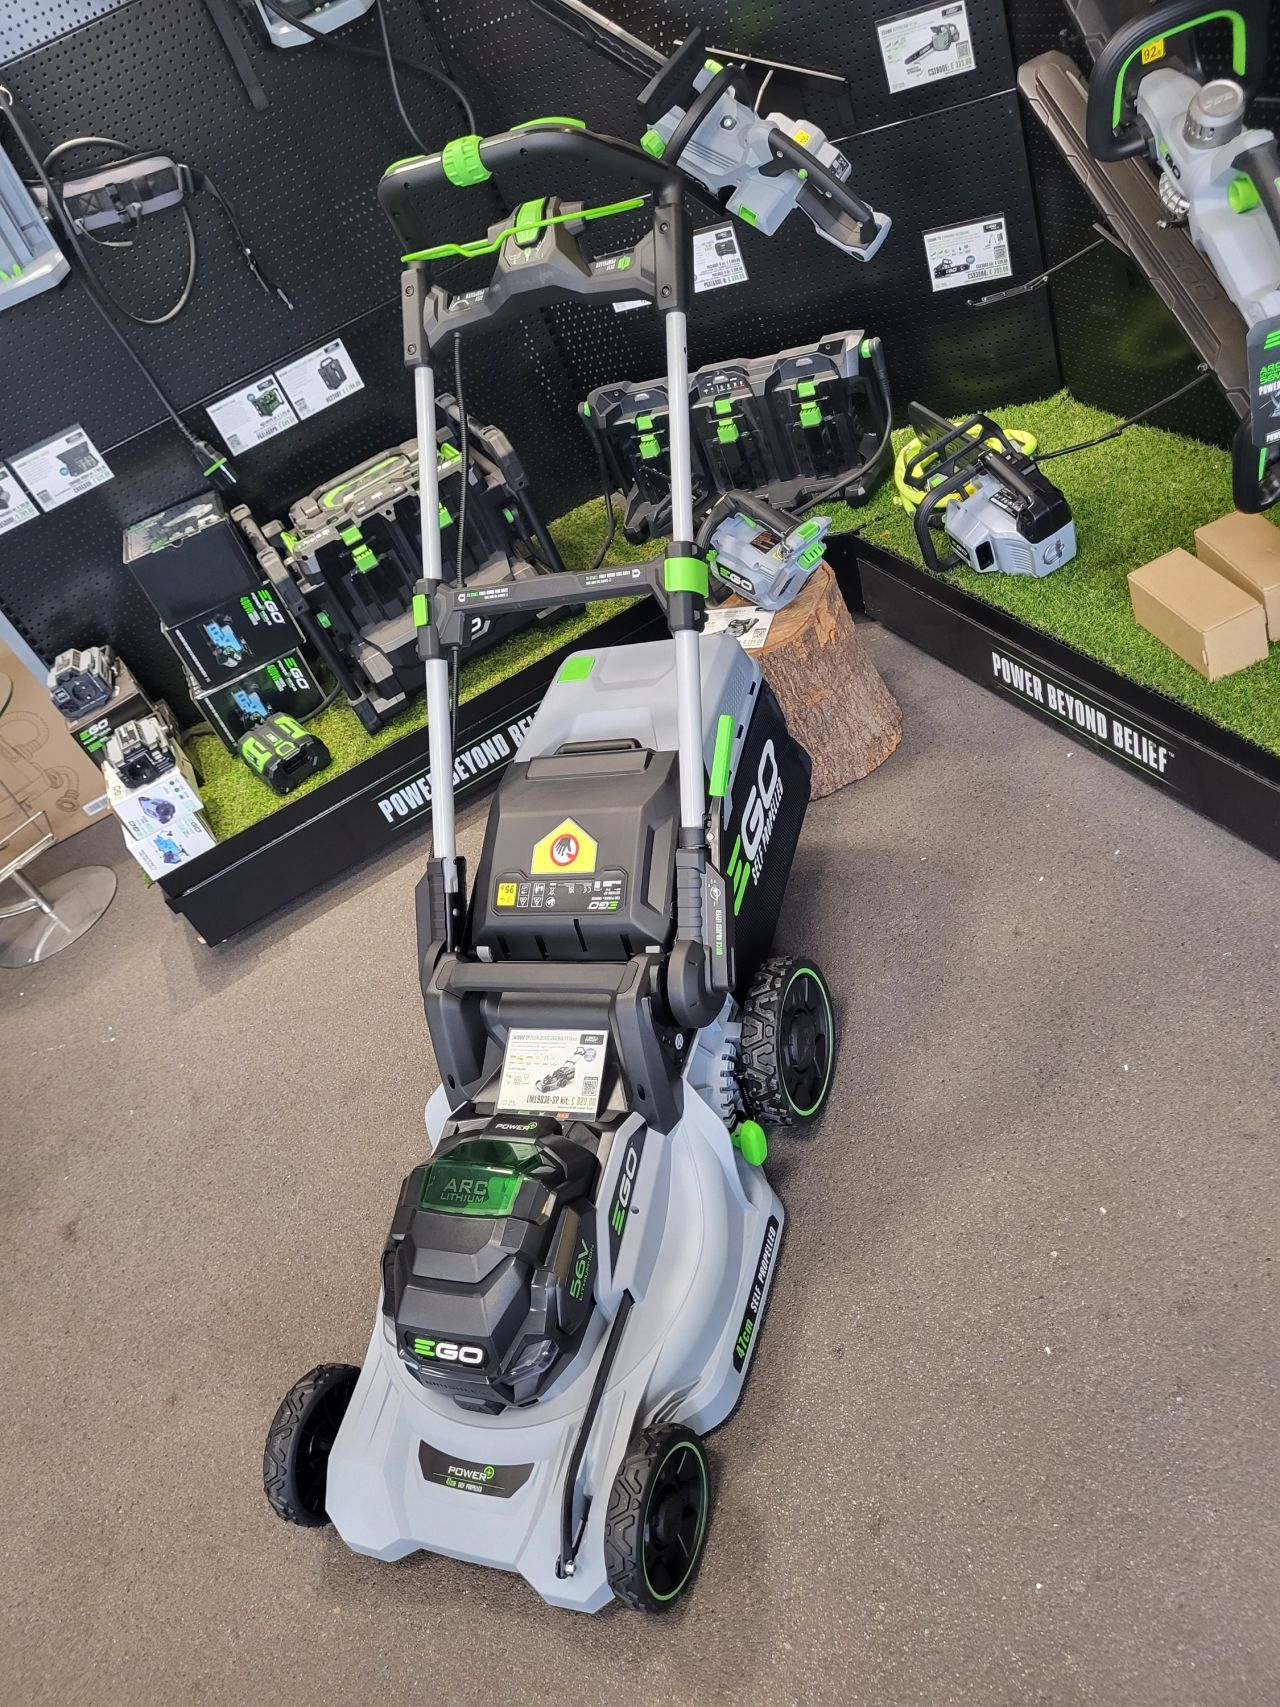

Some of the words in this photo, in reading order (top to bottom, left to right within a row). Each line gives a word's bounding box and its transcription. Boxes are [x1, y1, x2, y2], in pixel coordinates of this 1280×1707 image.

[1143, 46, 1157, 59] 92
[719, 567, 752, 591] EGO
[257, 590, 285, 623] EGO
[284, 657, 310, 689] EGO
[991, 651, 1044, 704] POWER
[1047, 683, 1108, 740] BEYOND
[79, 718, 108, 741] EGO
[378, 773, 432, 824] POWE
[726, 739, 778, 916] EGO
[751, 844, 764, 886] SELF
[762, 776, 784, 853] PROPELLED
[587, 901, 618, 910] EGO
[440, 1192, 485, 1204] LITHIUM
[443, 1178, 488, 1195] ARC
[612, 1147, 637, 1236] EGO
[570, 1238, 589, 1299] 56V
[735, 1317, 754, 1359] 47cm
[750, 1285, 763, 1313] SELF
[758, 1225, 777, 1284] PROPELLED
[414, 1338, 483, 1364] EGO
